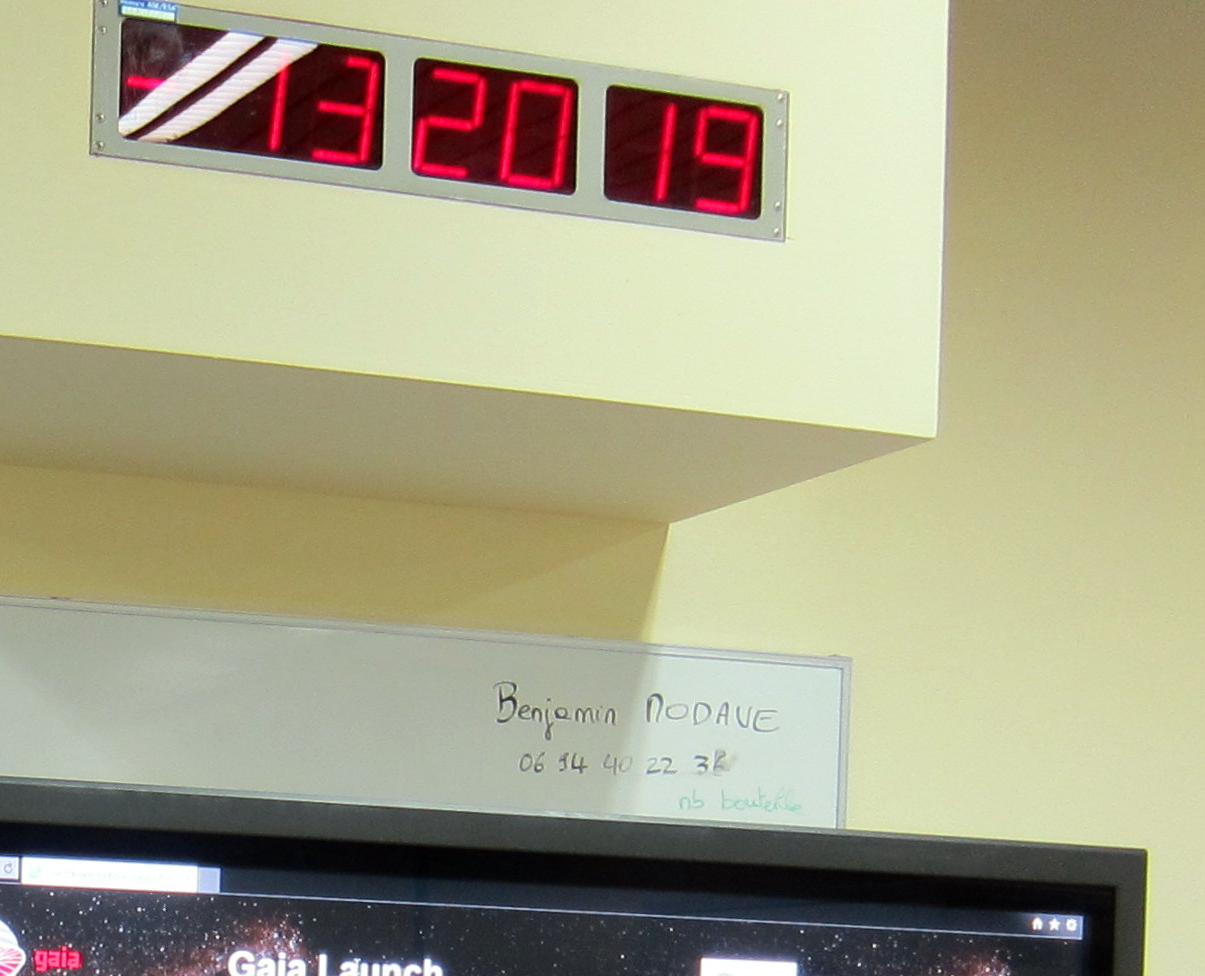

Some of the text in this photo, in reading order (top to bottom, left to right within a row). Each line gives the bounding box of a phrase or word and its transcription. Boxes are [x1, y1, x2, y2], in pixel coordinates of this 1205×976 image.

[411, 68, 574, 190] 20
[654, 102, 759, 213] 19
[494, 681, 617, 741] Benjamin
[519, 752, 546, 773] 06
[646, 757, 677, 775] 22
[34, 945, 82, 973] gaia
